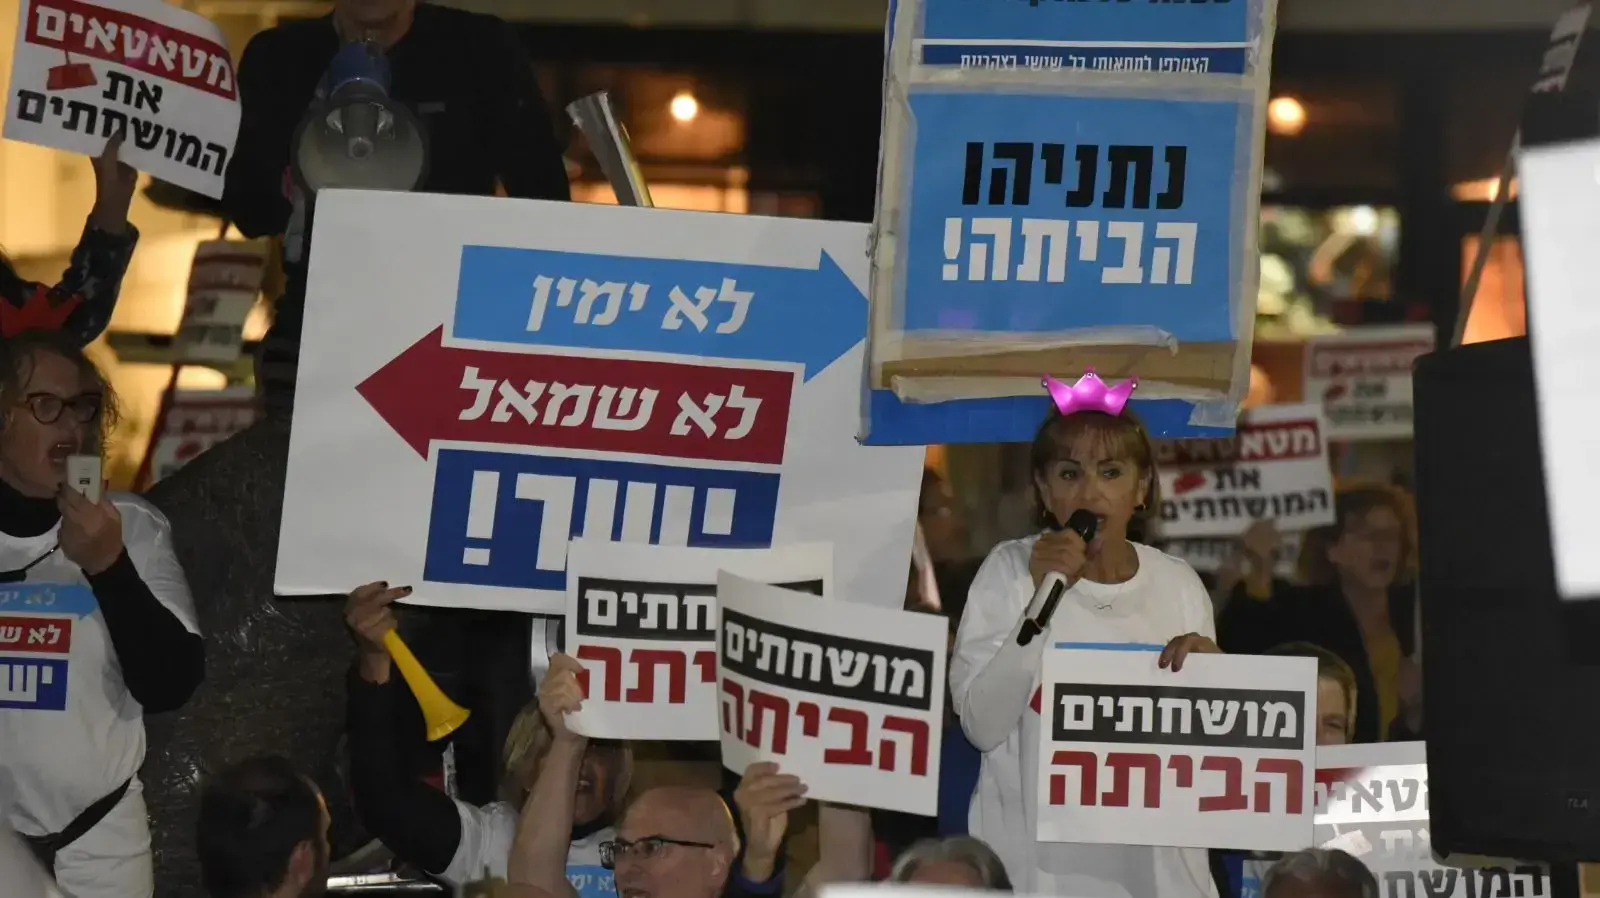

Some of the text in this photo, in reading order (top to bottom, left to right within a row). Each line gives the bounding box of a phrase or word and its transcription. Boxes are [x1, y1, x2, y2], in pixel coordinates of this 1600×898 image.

[34, 4, 234, 92] מטאטאים
[1024, 55, 1063, 72] שישי
[102, 70, 163, 115] את
[16, 89, 229, 176] המושחתים
[962, 142, 1187, 209] נתניהו
[942, 217, 1198, 285] הביתה!
[526, 274, 755, 334] לא ימין
[459, 365, 763, 440] לא שמאל
[1161, 488, 1328, 520] המושחתים
[1214, 468, 1260, 490] את
[462, 470, 737, 572] ישר!
[27, 624, 61, 645] לא
[724, 620, 926, 698] מושחתים
[722, 678, 930, 776] הביתה
[1060, 694, 1297, 738] מושחתים
[1049, 750, 1304, 814] הביתה
